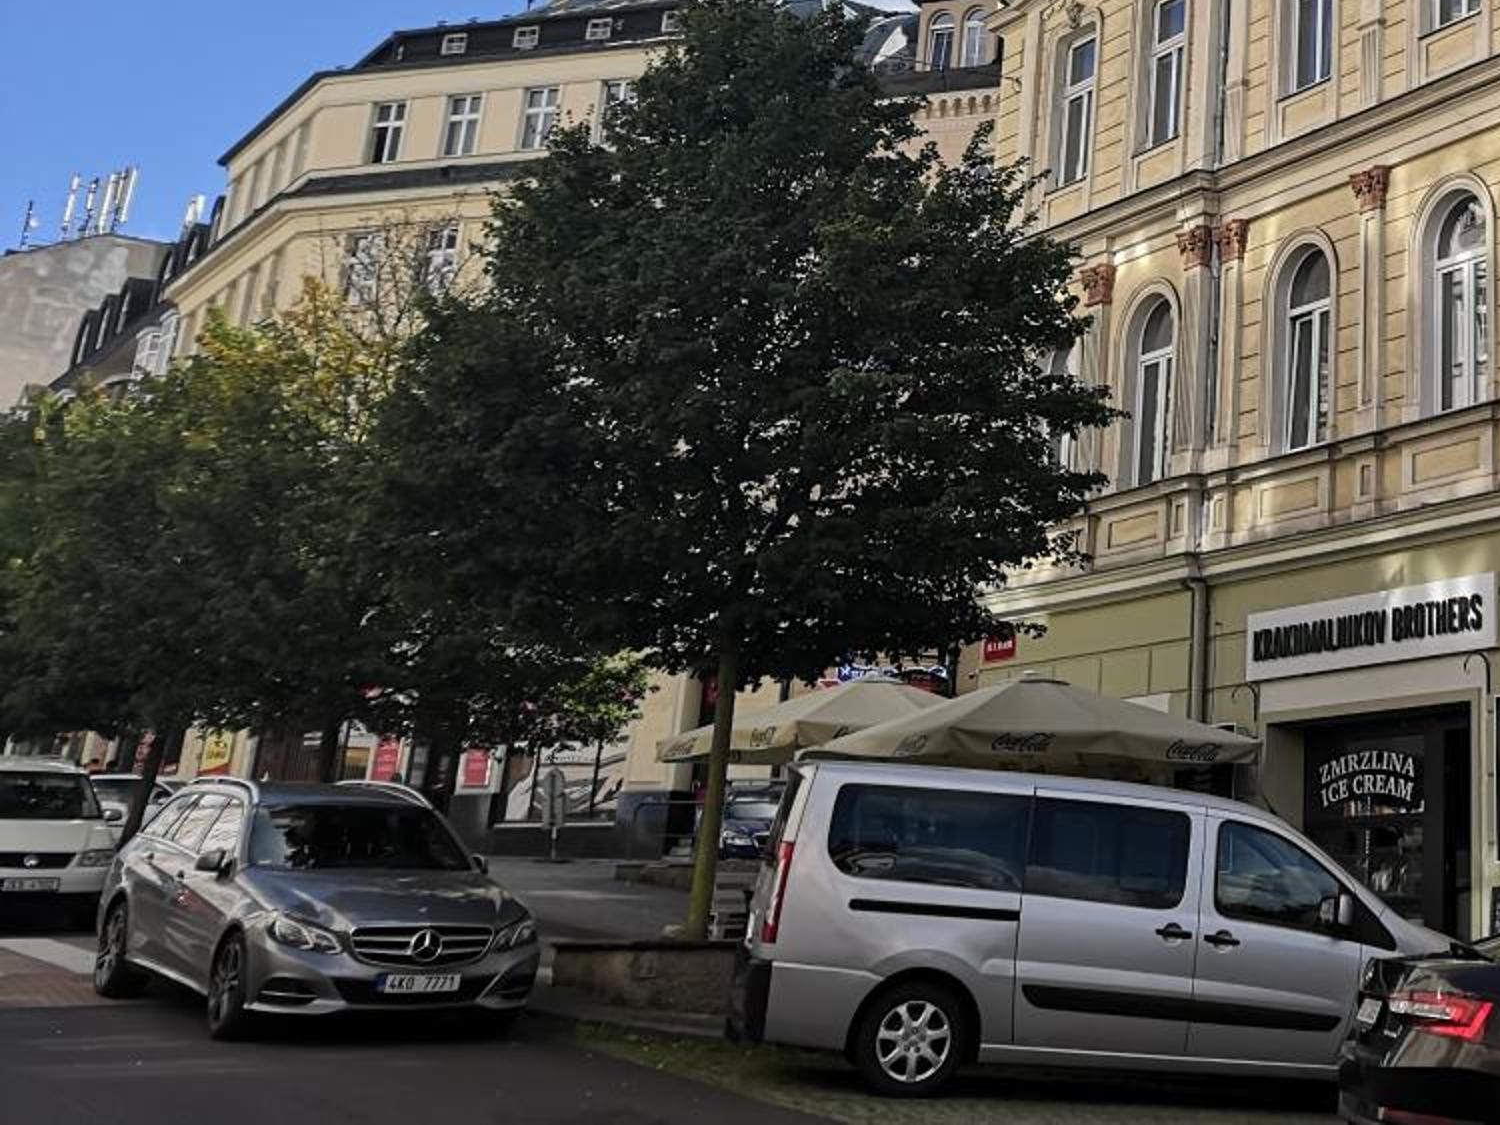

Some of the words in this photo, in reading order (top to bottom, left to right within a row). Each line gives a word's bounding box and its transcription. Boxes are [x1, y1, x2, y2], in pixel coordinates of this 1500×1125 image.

[1392, 593, 1483, 642] BROTHERS
[1318, 749, 1416, 785] ZMRZLINA
[1320, 778, 1350, 808] ICE
[1353, 774, 1415, 802] CREAM
[424, 976, 456, 990] 7771
